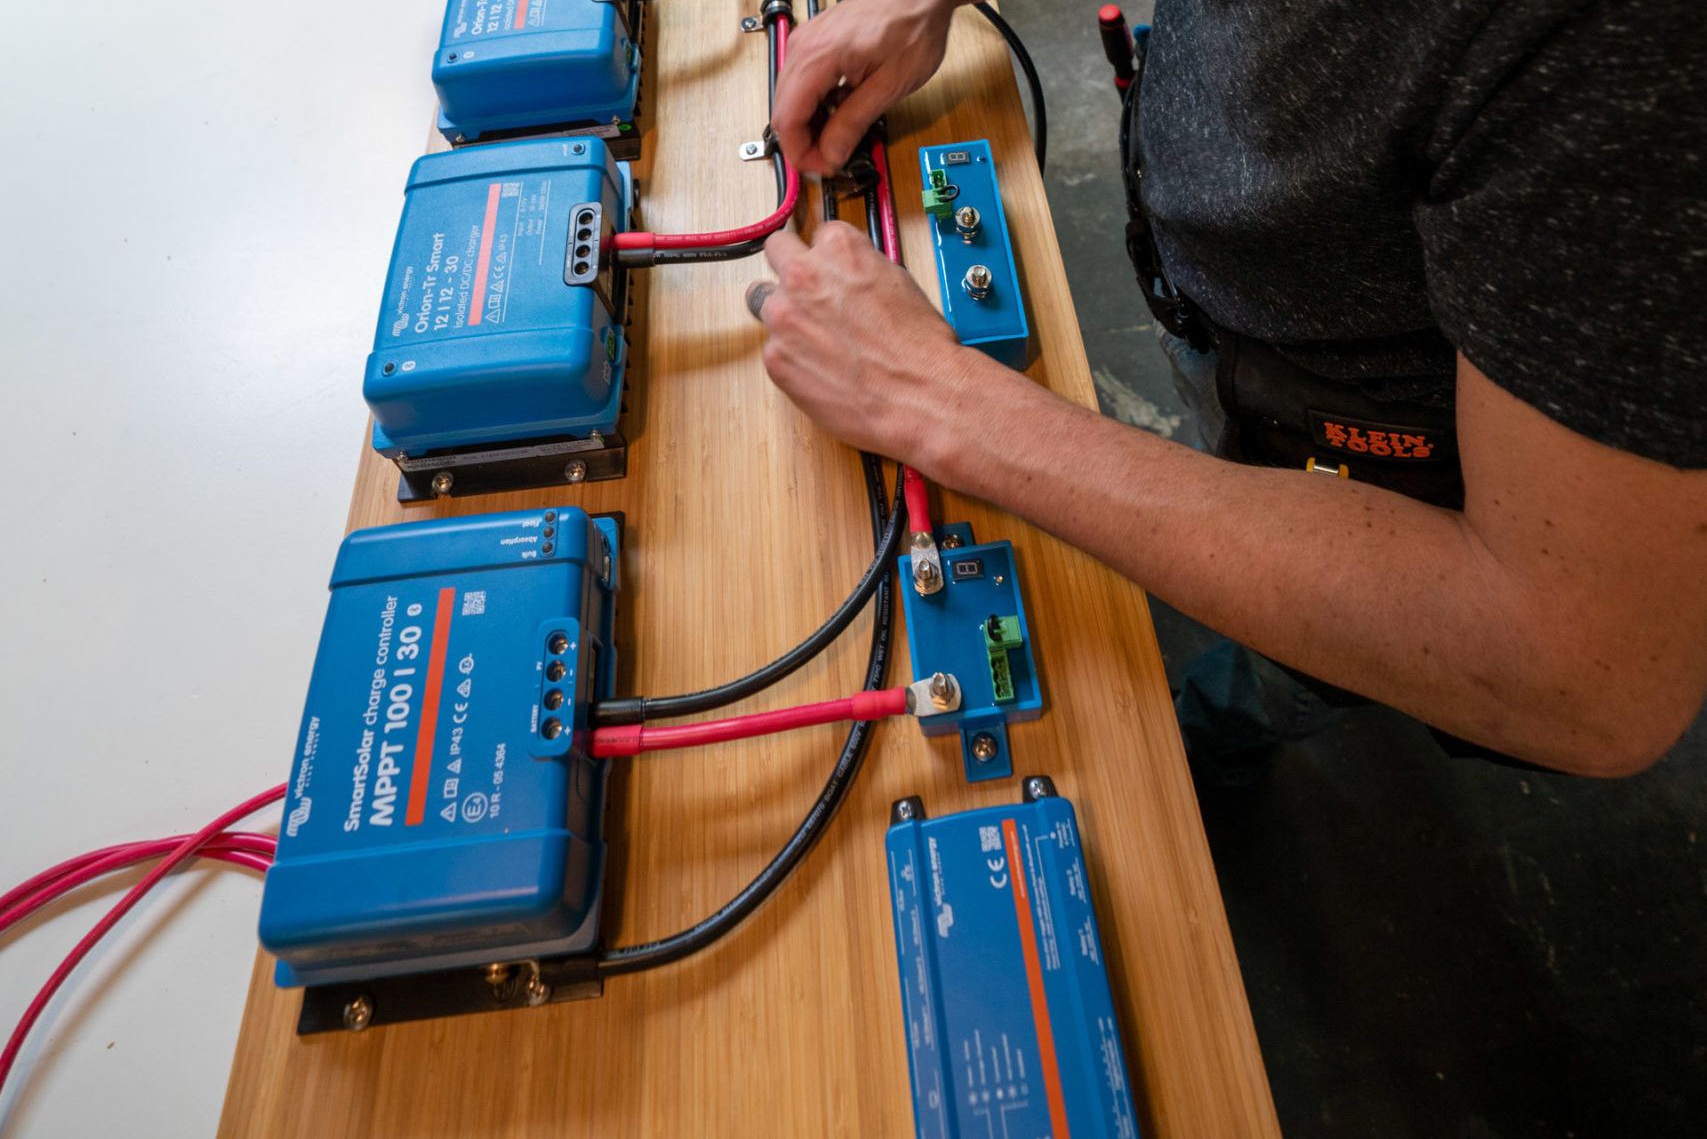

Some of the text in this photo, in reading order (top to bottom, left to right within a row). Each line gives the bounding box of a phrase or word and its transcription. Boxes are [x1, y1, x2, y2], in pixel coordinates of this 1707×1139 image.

[491, 4, 501, 14] 12
[487, 21, 498, 33] 12
[445, 255, 459, 273] 30
[454, 225, 481, 327] isolated DC/DC charger
[398, 266, 413, 313] victron energy
[414, 232, 445, 333] Orion-Tr Smart
[439, 287, 453, 301] 12
[434, 313, 448, 330] 12
[1328, 436, 1431, 458] TOOLS
[500, 536, 538, 545] Absorption
[522, 551, 537, 559] Bulk
[395, 624, 422, 660] 30
[383, 682, 413, 733] 100
[530, 661, 542, 732] BATTERY PV
[342, 594, 398, 831] SmartSolar charge controller
[450, 727, 463, 754] IP43
[293, 715, 320, 798] victron energy
[494, 743, 506, 768] 4364
[368, 739, 405, 827] MPPT
[491, 792, 501, 802] R
[490, 804, 499, 817] 10
